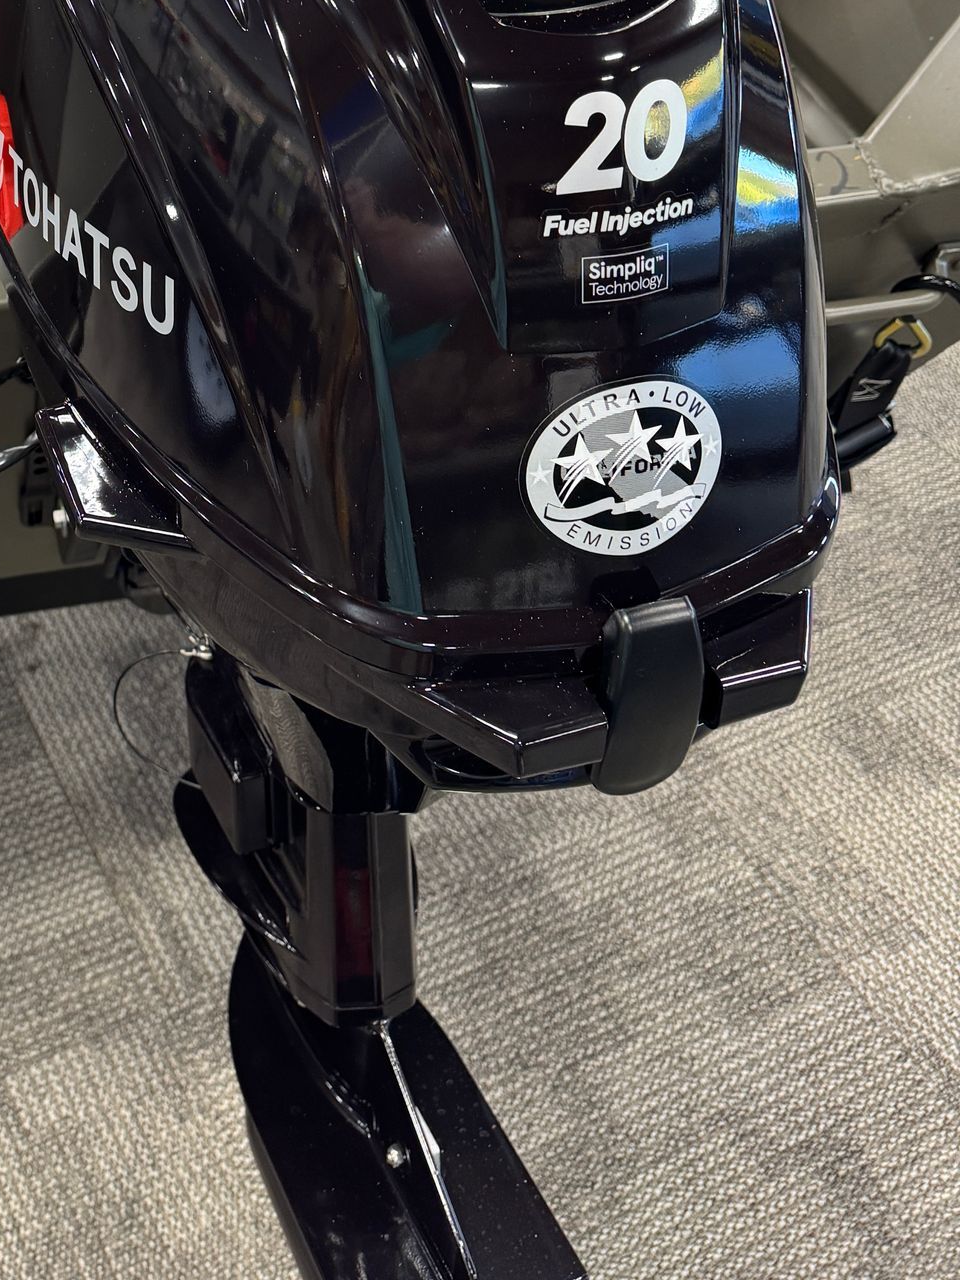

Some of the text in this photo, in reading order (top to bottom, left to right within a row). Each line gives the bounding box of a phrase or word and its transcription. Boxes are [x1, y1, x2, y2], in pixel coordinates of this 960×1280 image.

[556, 79, 688, 196] 20
[8, 144, 175, 336] TOHATSU
[543, 196, 695, 238] Fuel Injection
[589, 273, 664, 297] Technology
[552, 386, 707, 438] ULTRA LOW
[566, 502, 694, 551] EMISSION
